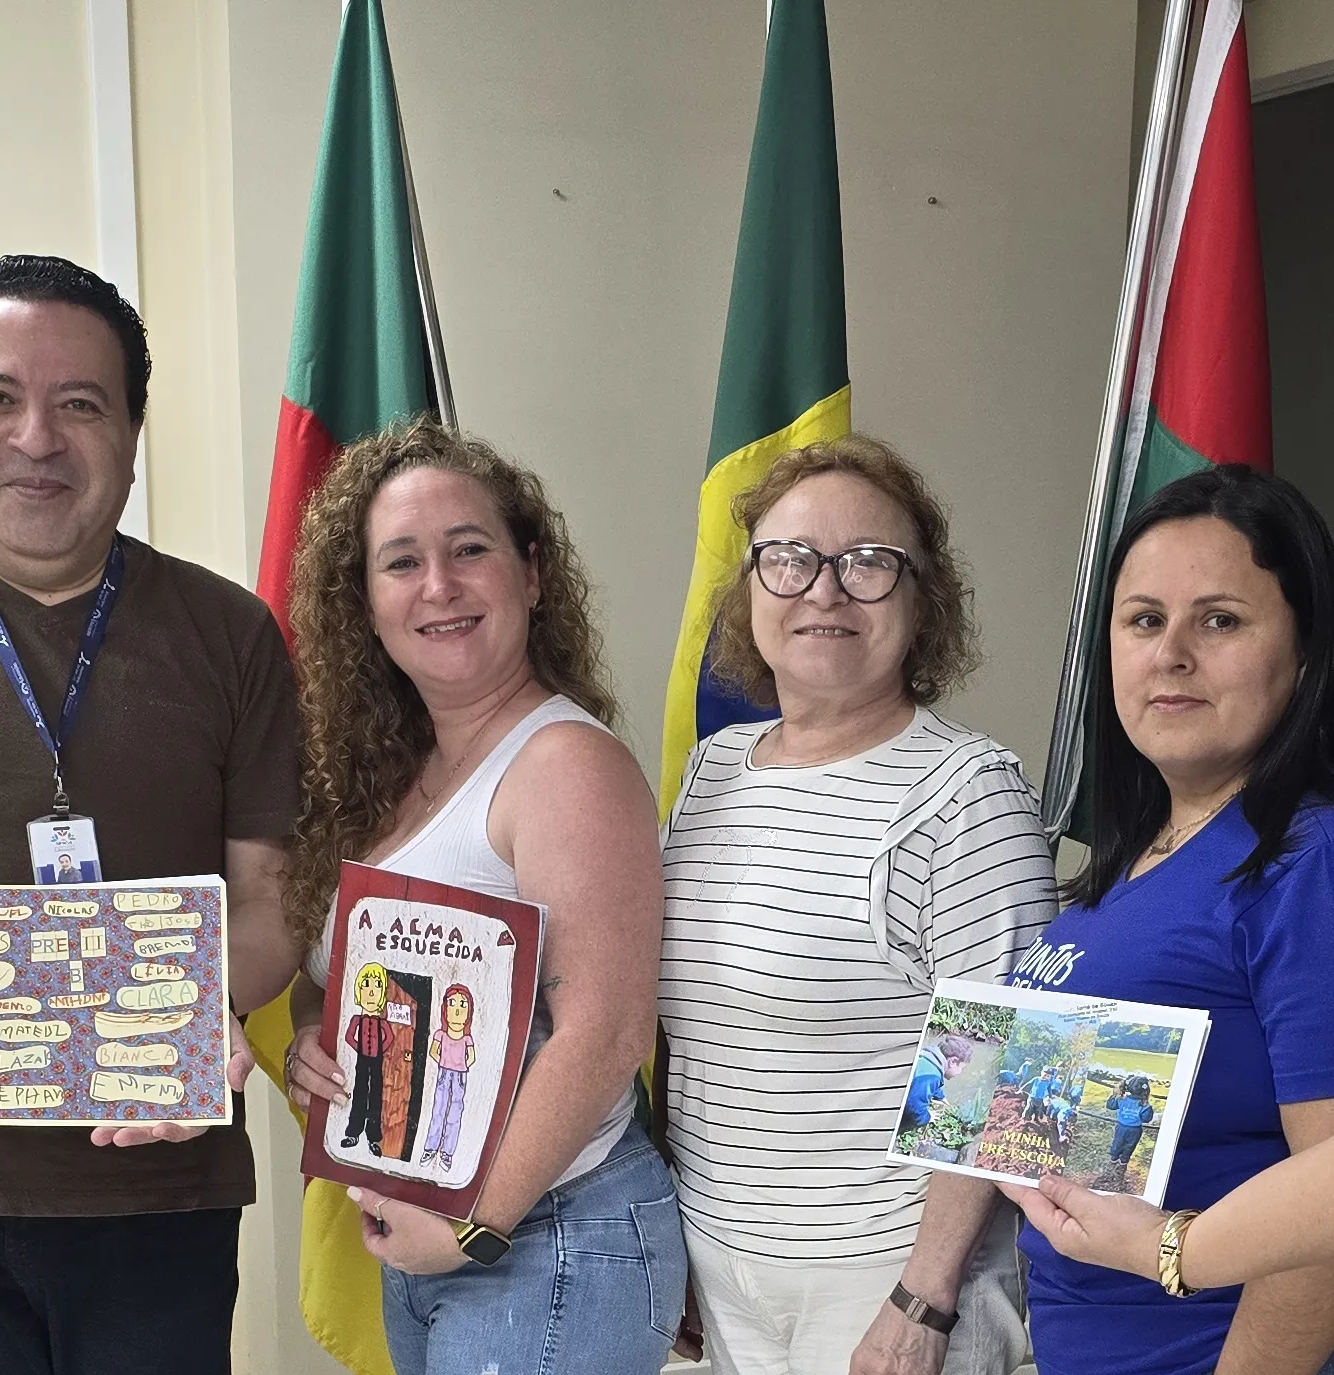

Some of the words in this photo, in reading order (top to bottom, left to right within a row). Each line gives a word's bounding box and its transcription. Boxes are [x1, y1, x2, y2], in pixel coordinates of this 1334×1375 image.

[117, 894, 179, 908] PEDRO
[359, 909, 373, 930] A
[376, 933, 483, 963] ESQUECIDA
[70, 968, 82, 983] B
[120, 982, 194, 1009] CLARA
[1002, 1130, 1051, 1149] MINHA
[978, 1141, 1066, 1168] PRÉ-ESCOLA
